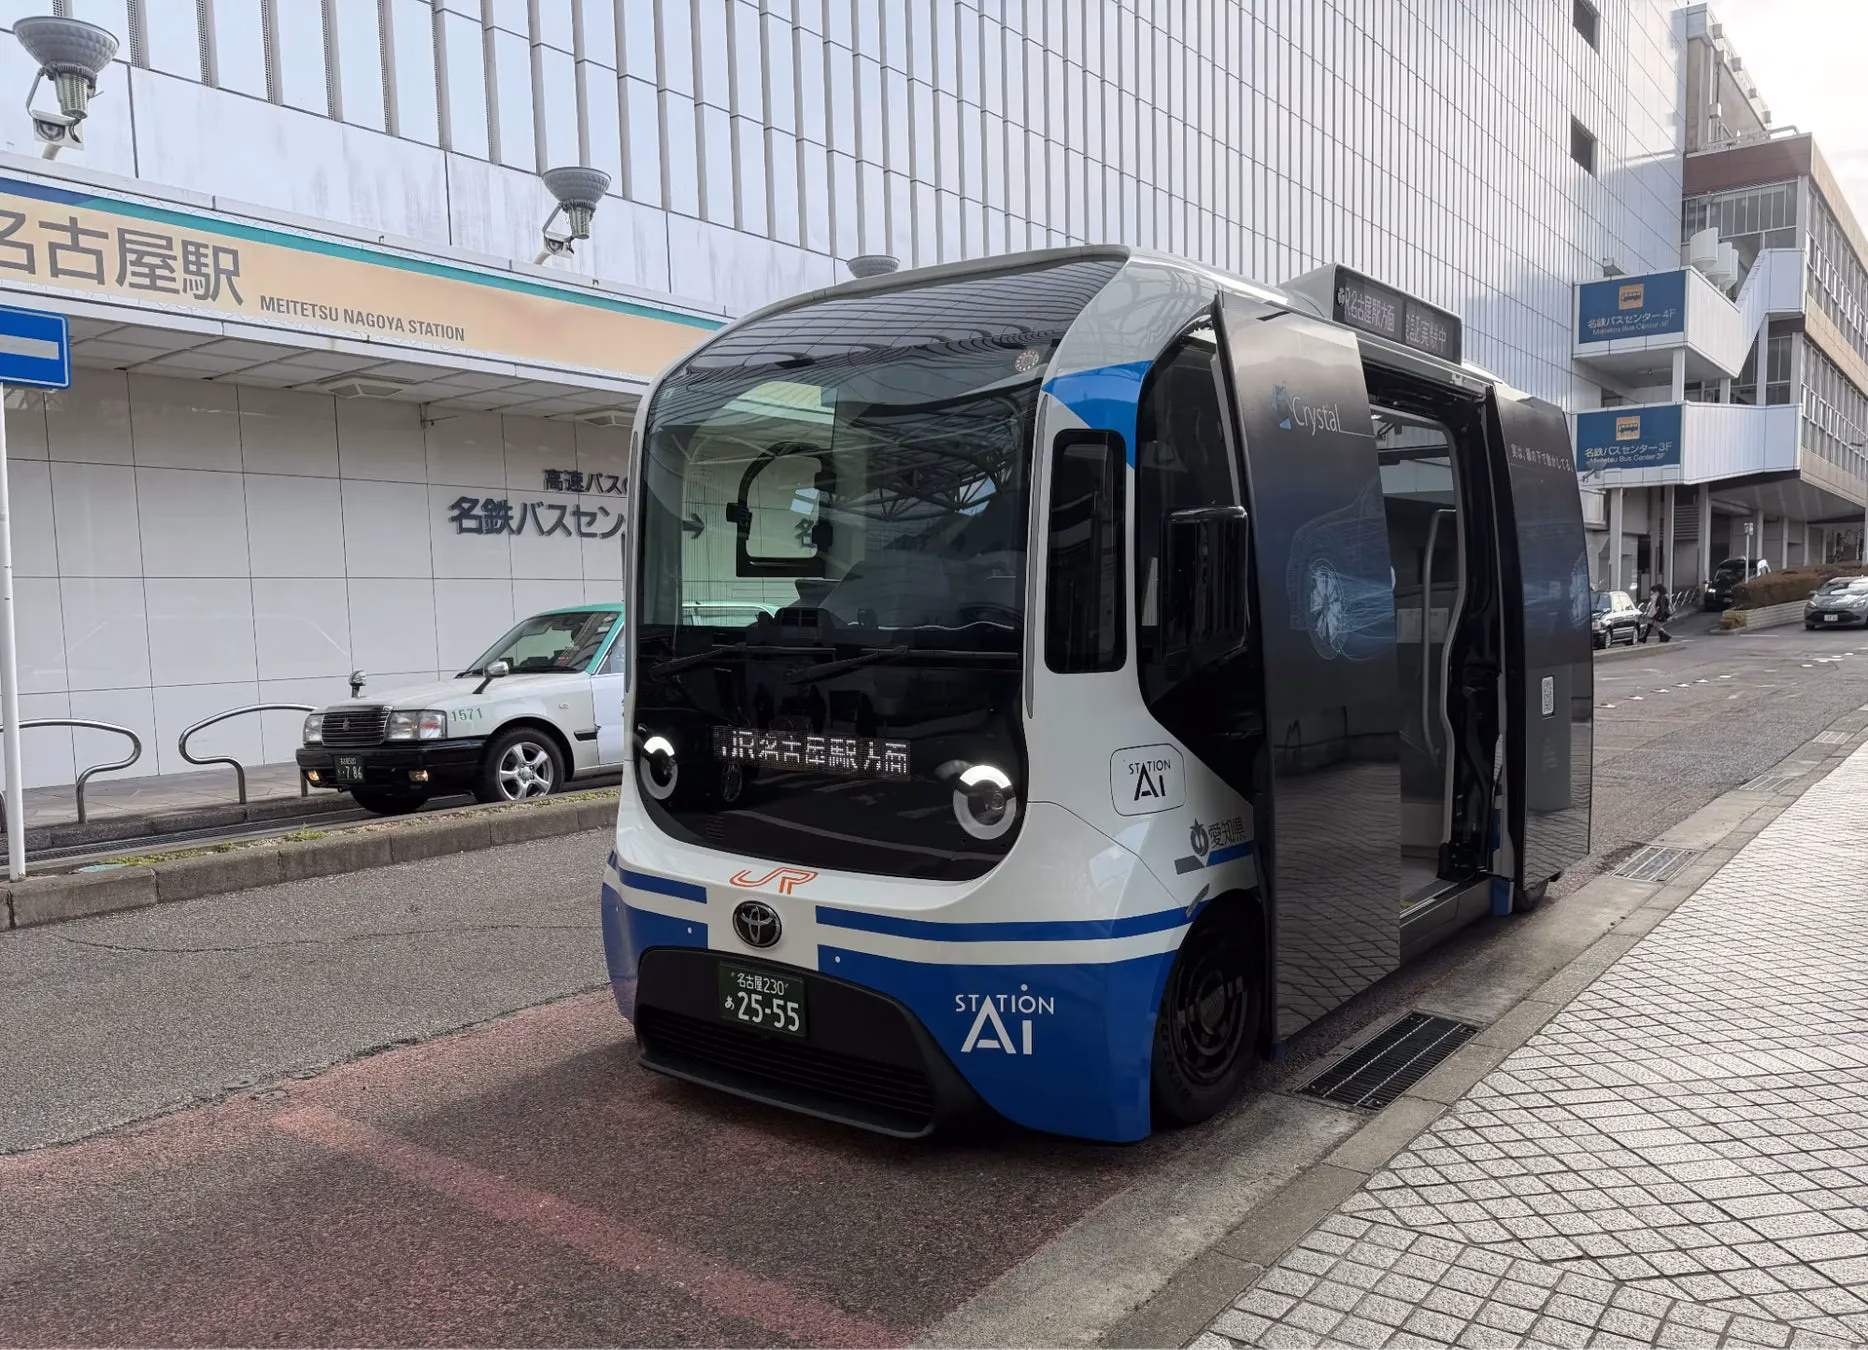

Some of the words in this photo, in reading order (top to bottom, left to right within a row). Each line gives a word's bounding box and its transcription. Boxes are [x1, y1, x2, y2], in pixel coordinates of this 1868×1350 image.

[260, 295, 339, 322] MEITETSU
[343, 308, 405, 333] NAGOYA
[408, 320, 465, 341] STATION
[1292, 395, 1342, 437] Crystal
[543, 469, 628, 494] 高速バス
[448, 496, 627, 539] 名鉄バスセン
[451, 707, 483, 722] 1571
[1128, 759, 1171, 775] STATION
[1208, 816, 1246, 849] 愛知県
[729, 866, 819, 895] JR
[737, 991, 800, 1032] 25-55
[955, 993, 1054, 1015] STATION
